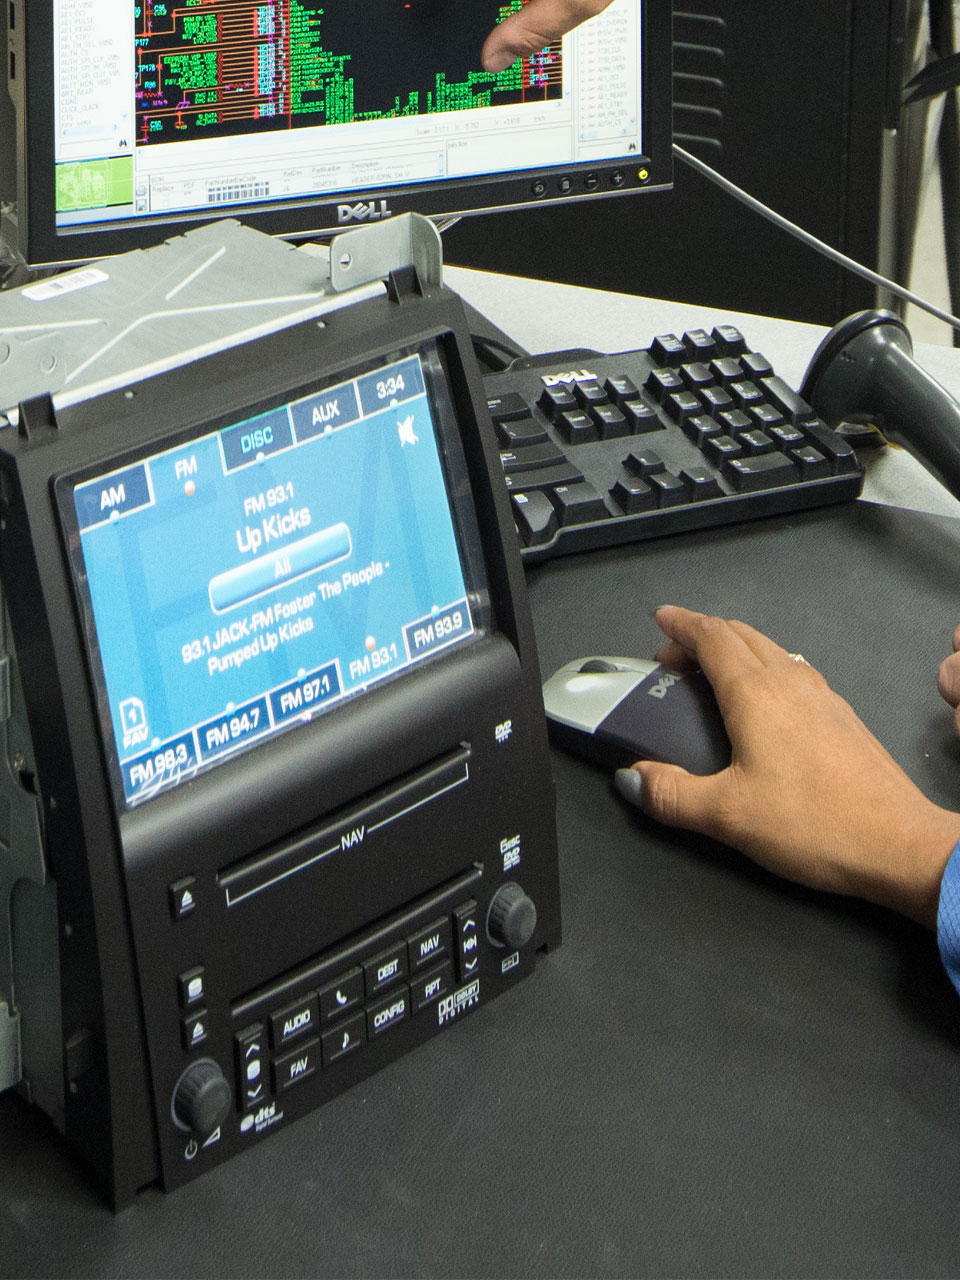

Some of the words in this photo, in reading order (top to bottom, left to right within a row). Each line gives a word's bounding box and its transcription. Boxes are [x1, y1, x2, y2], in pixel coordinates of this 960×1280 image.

[338, 200, 392, 222] DELL
[376, 375, 405, 400] 3:34
[541, 369, 598, 387] DELL
[312, 399, 340, 425] AUX
[241, 426, 274, 454] DISC
[175, 456, 198, 480] FM
[100, 484, 126, 510] AM
[244, 493, 265, 517] FM
[266, 481, 296, 508] 93.1
[236, 528, 262, 555] Up
[263, 506, 312, 544] Kicks
[274, 559, 292, 580] All
[181, 637, 212, 665] 93.1
[212, 612, 274, 651] JACK-FM
[274, 593, 317, 628] Foster
[318, 580, 342, 603] The
[342, 563, 385, 594] People
[414, 627, 435, 649] FM
[434, 613, 463, 641] 93.9
[207, 646, 260, 677] Pumped
[259, 631, 280, 657] Up
[280, 617, 315, 643] Kicks
[349, 657, 371, 680] FM
[370, 643, 399, 673] 93.1
[280, 691, 303, 715] FM
[302, 674, 331, 705] 97.1
[123, 726, 149, 750] FAV
[205, 726, 230, 750] FM
[229, 708, 261, 739] 94.7
[130, 763, 155, 788] FM
[341, 826, 365, 851] NAV
[420, 934, 441, 957] NAV
[425, 977, 442, 998] RPT
[456, 985, 477, 1003] DOLBY
[283, 1010, 311, 1037] AUDIO
[374, 1000, 405, 1029] CONFIG
[438, 995, 480, 1026] DIGITAL
[290, 1055, 308, 1079] FAV
